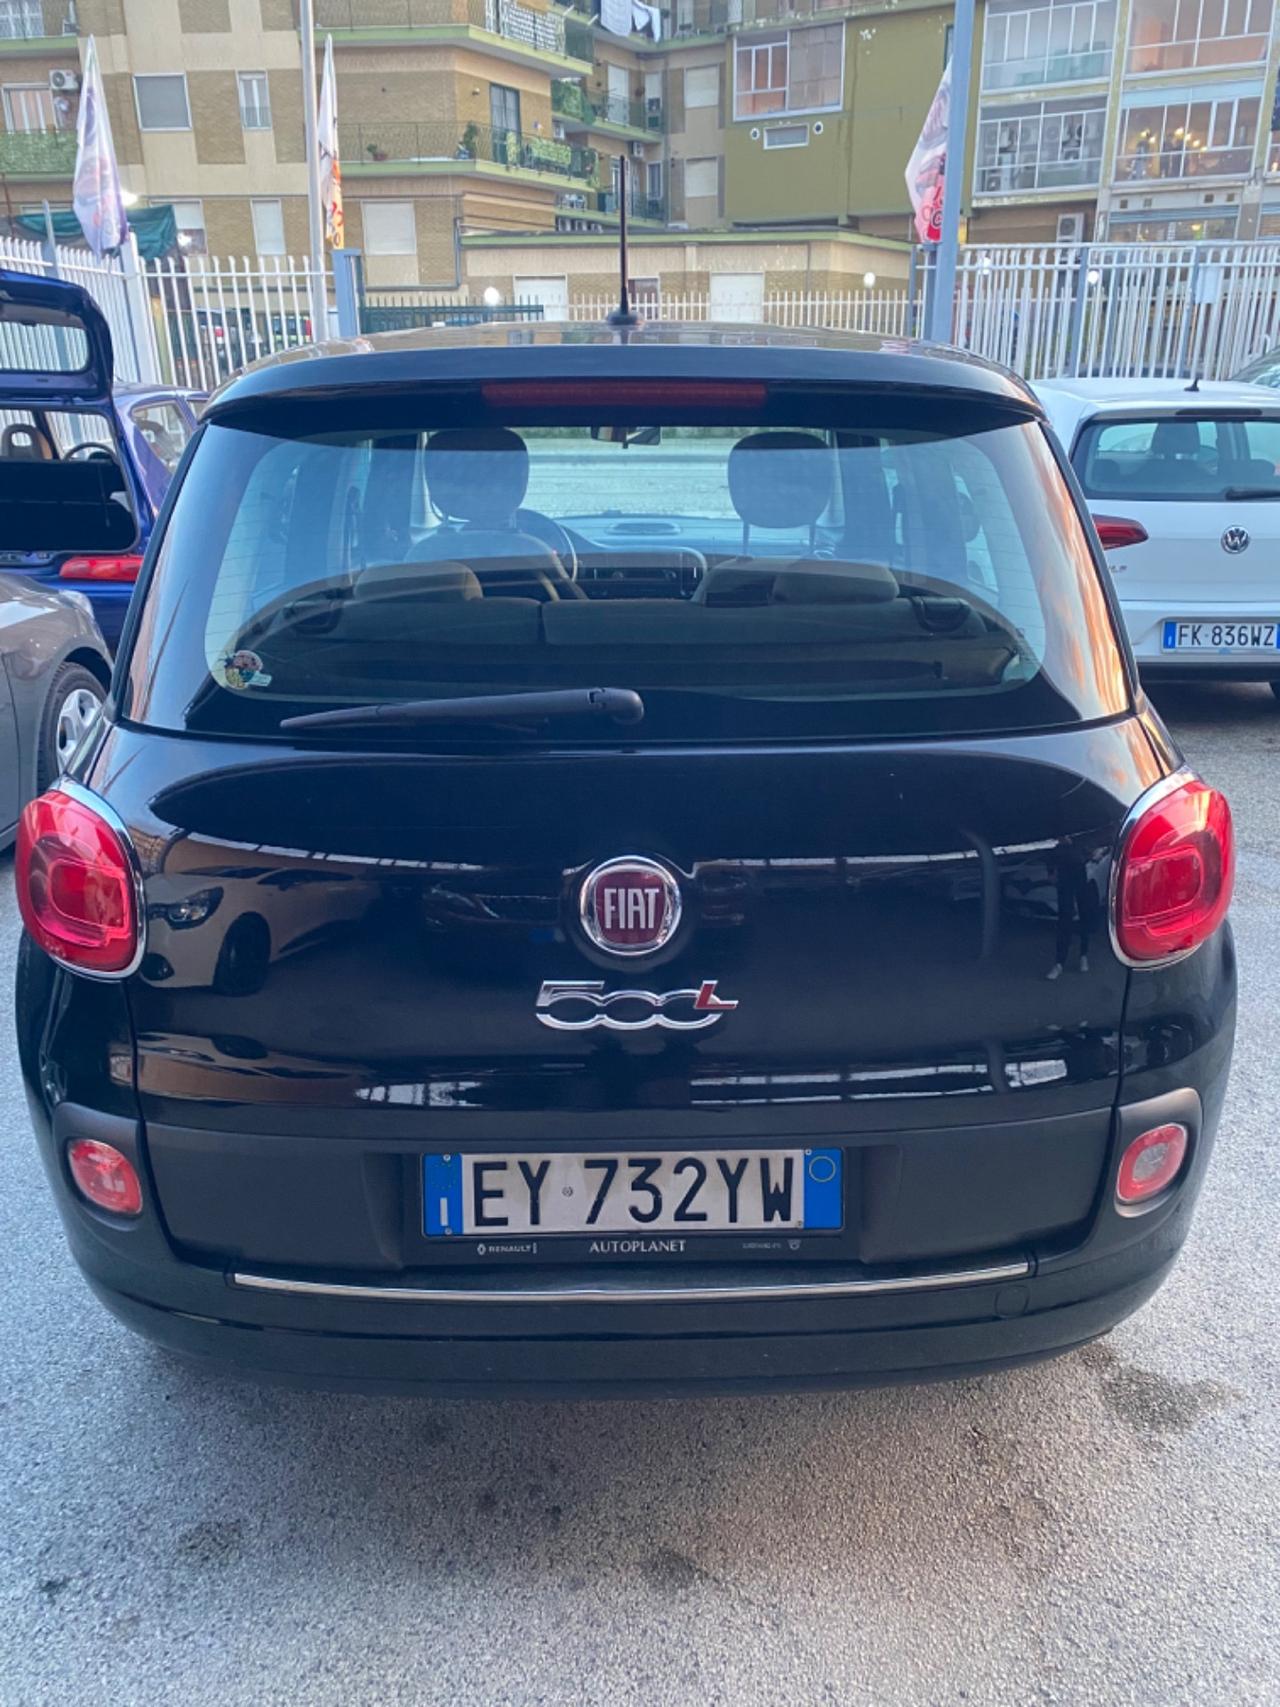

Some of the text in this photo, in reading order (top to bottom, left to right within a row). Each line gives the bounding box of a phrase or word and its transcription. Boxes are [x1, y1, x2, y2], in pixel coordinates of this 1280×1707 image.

[1178, 624, 1275, 646] FK 836WZ
[603, 888, 659, 929] FIAT
[473, 1157, 794, 1227] EY 732YW
[589, 1239, 687, 1254] AUTOPLANET
